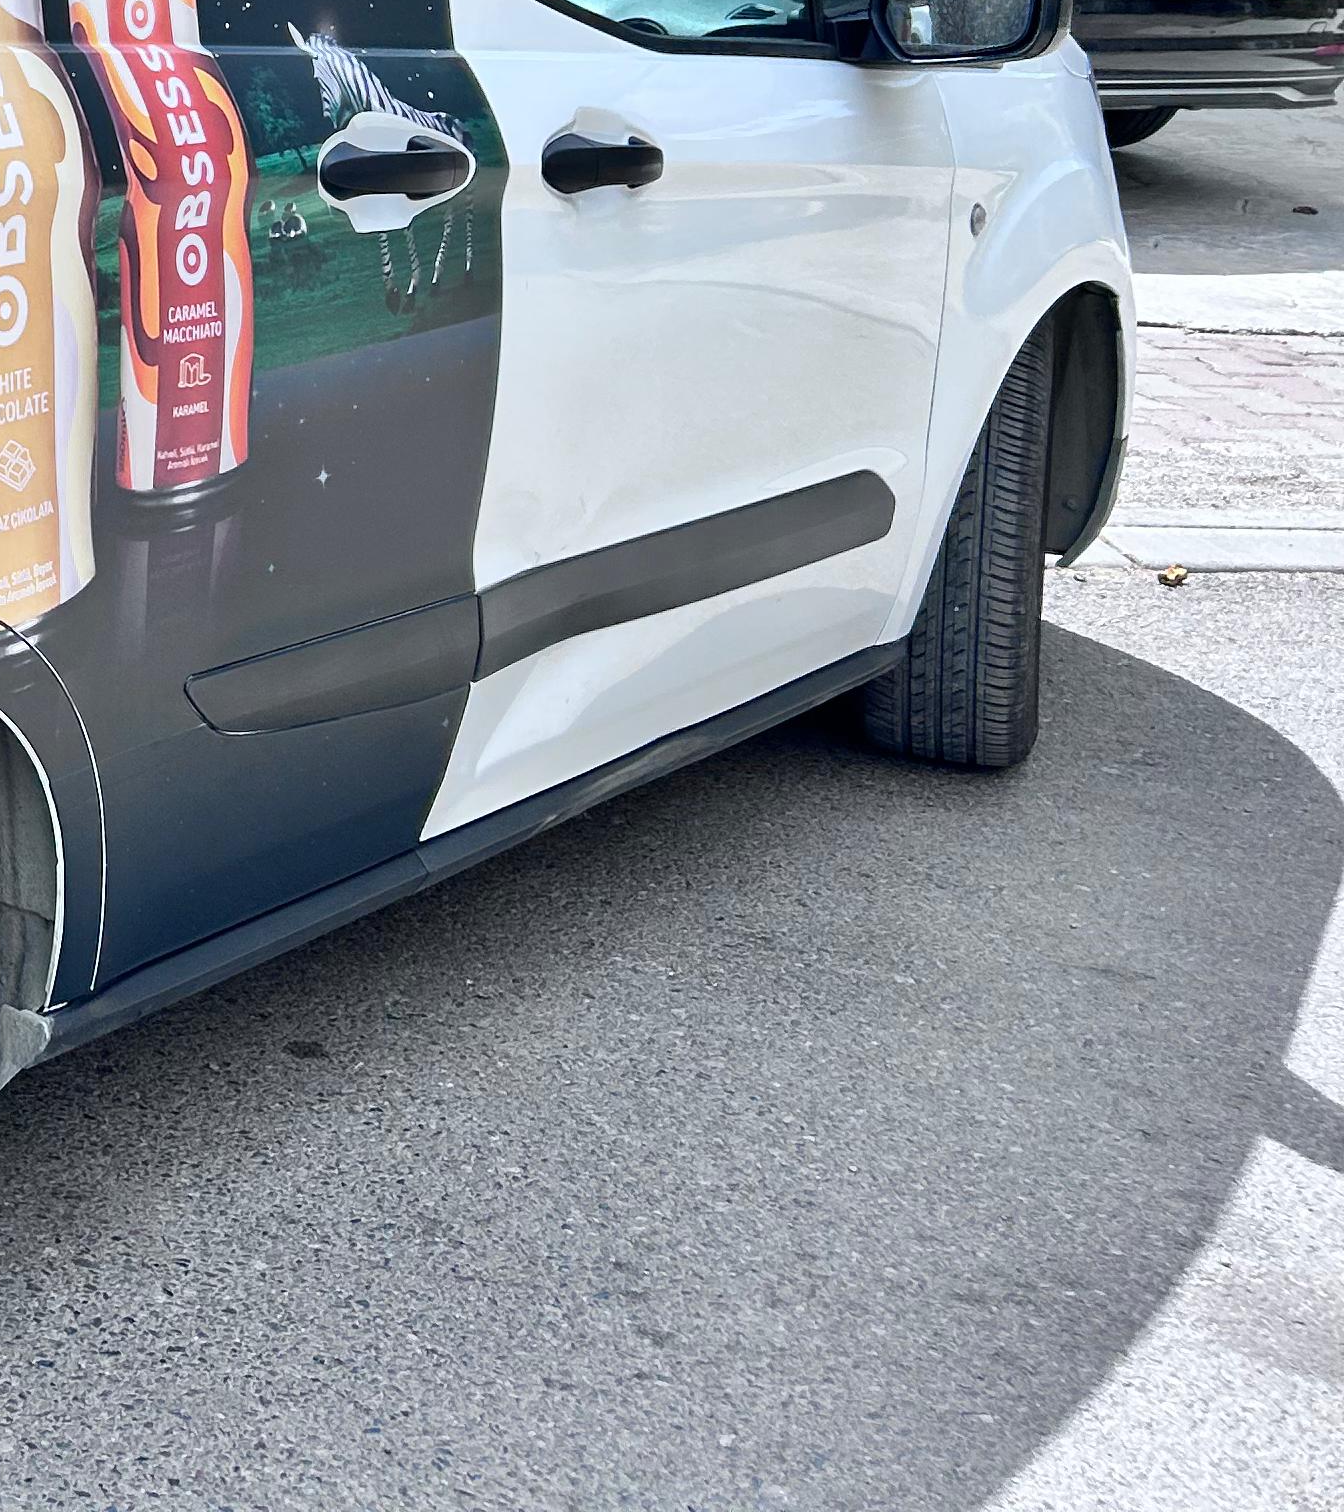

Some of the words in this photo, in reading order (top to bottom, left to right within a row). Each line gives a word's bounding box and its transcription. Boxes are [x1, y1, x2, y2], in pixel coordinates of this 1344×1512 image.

[168, 301, 218, 324] CARAMEL
[163, 320, 223, 345] MACCHIATO
[172, 400, 210, 418] KARAMEL
